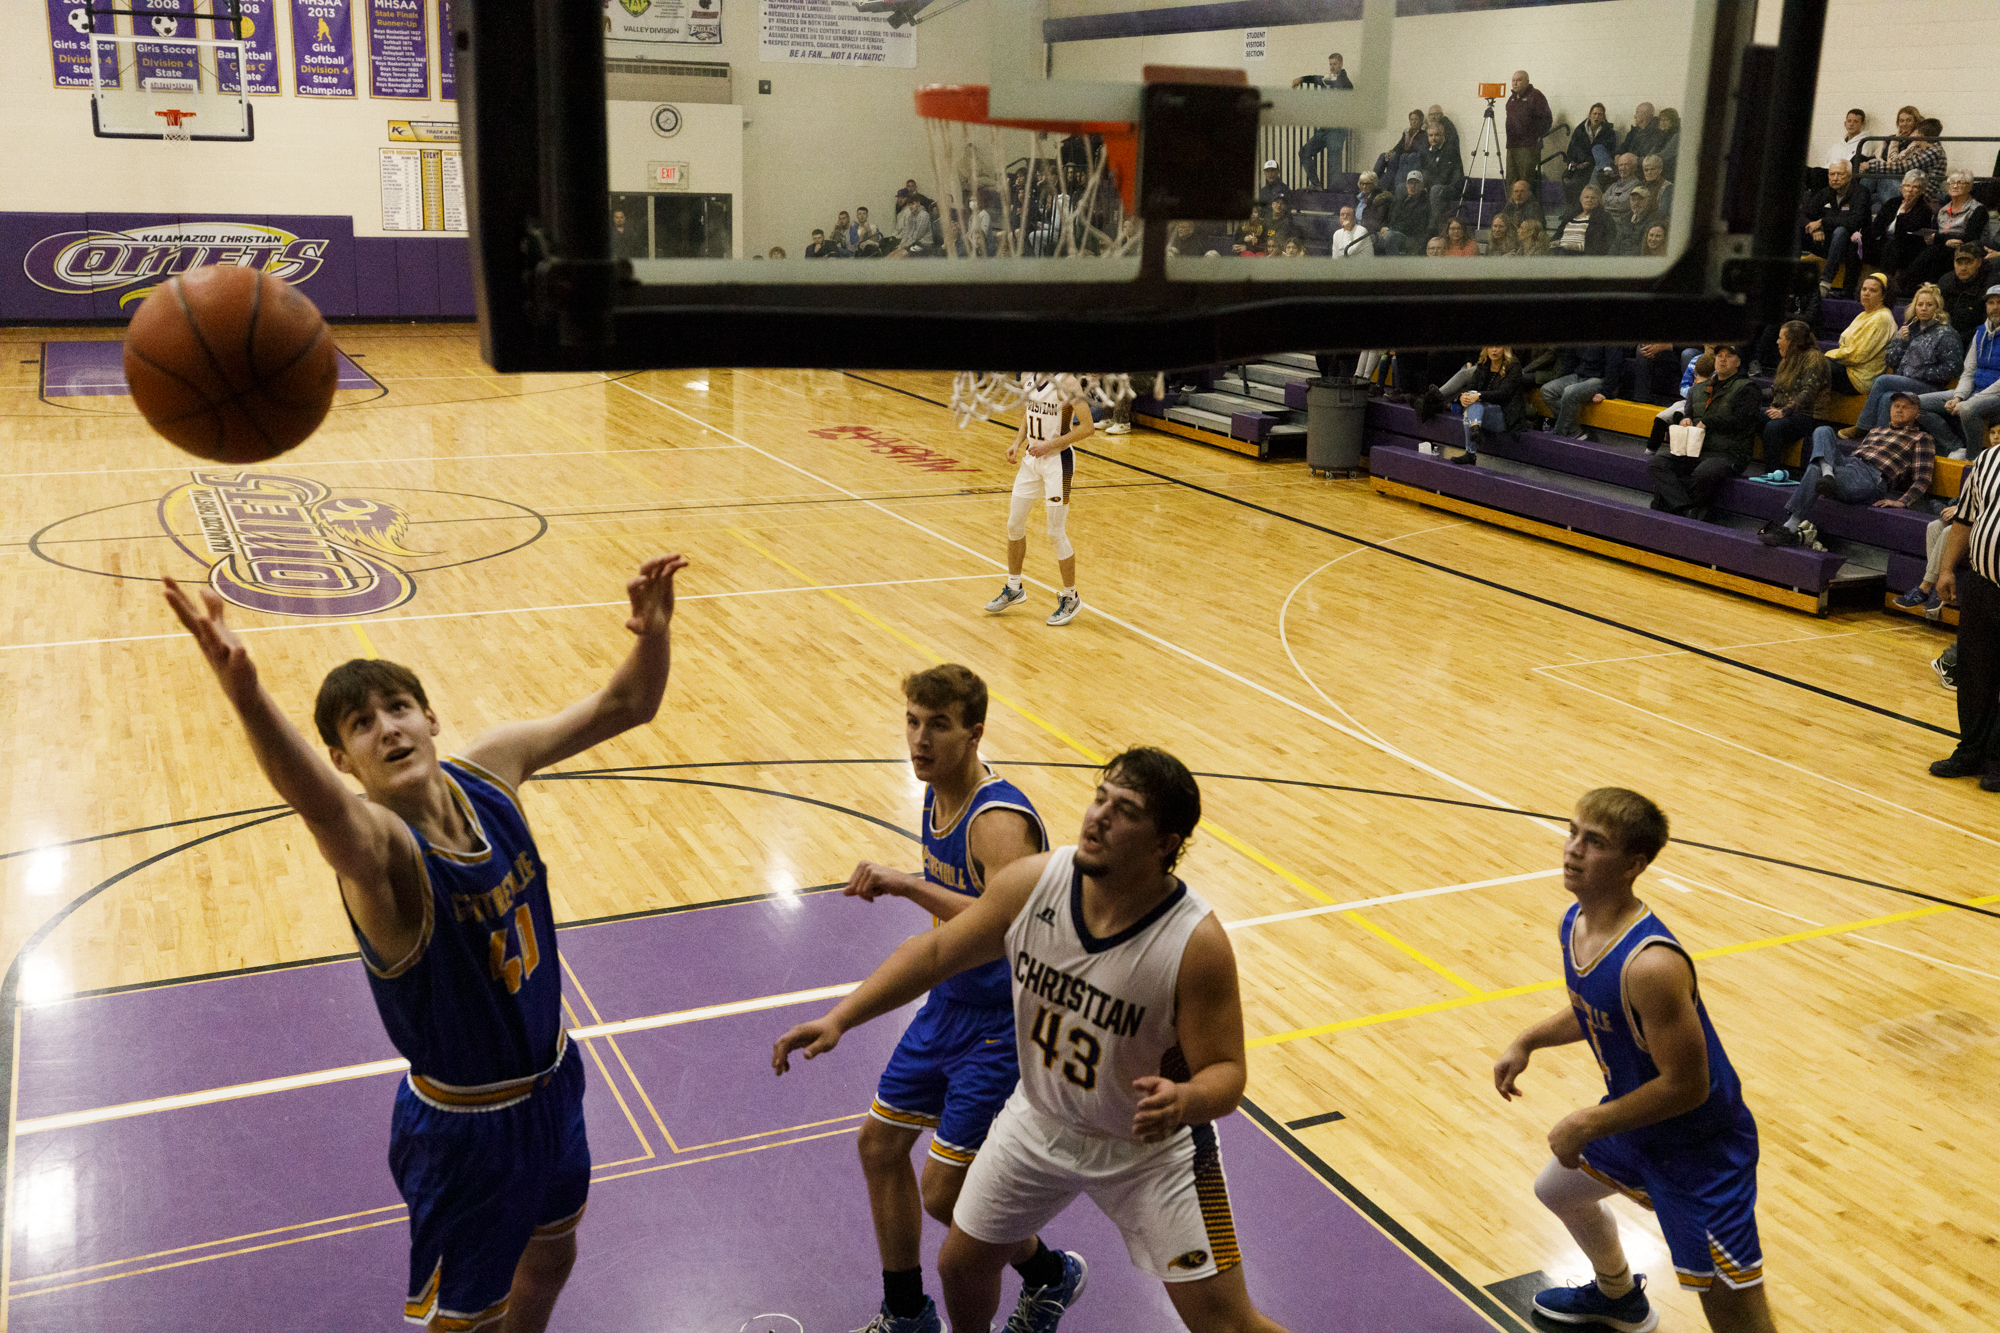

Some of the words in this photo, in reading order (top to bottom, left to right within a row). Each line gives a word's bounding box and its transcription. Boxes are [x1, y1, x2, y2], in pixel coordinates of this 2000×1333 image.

[146, 0, 180, 9] 2008
[374, 0, 417, 10] MHSAA
[308, 7, 335, 17] 2013
[377, 19, 417, 28] Runner-Up
[624, 26, 649, 34] VALLEY
[53, 40, 77, 49] Girls
[80, 41, 115, 50] Socer
[137, 44, 160, 53] Girls
[162, 45, 196, 54] Soccer
[312, 44, 336, 52] Girls
[105, 56, 112, 64] 4
[217, 50, 272, 60] Basetball
[304, 55, 344, 65] Softball
[800, 50, 806, 58] A
[846, 52, 852, 60] A
[854, 52, 886, 61] FANATIC!
[142, 58, 184, 67] Division
[187, 60, 193, 68] 4
[230, 62, 256, 71] Css
[73, 65, 100, 74] Stat
[156, 69, 182, 77] State
[301, 65, 340, 74] Division
[342, 66, 349, 74] 4
[58, 76, 117, 87] Champons
[236, 72, 262, 81] Sate
[313, 75, 338, 84] State
[142, 80, 194, 89] Champion
[300, 86, 352, 96] Champions
[662, 168, 676, 179] EXIT
[142, 234, 216, 243] KALAMAZOO
[220, 235, 282, 243] CHRISTIAN
[1029, 416, 1046, 441] 11
[190, 489, 221, 516] CHRISTIAN
[199, 517, 236, 552] KALAMAZOO
[1015, 952, 1146, 1037] CHRISTIAN
[1031, 1004, 1102, 1091] 43
